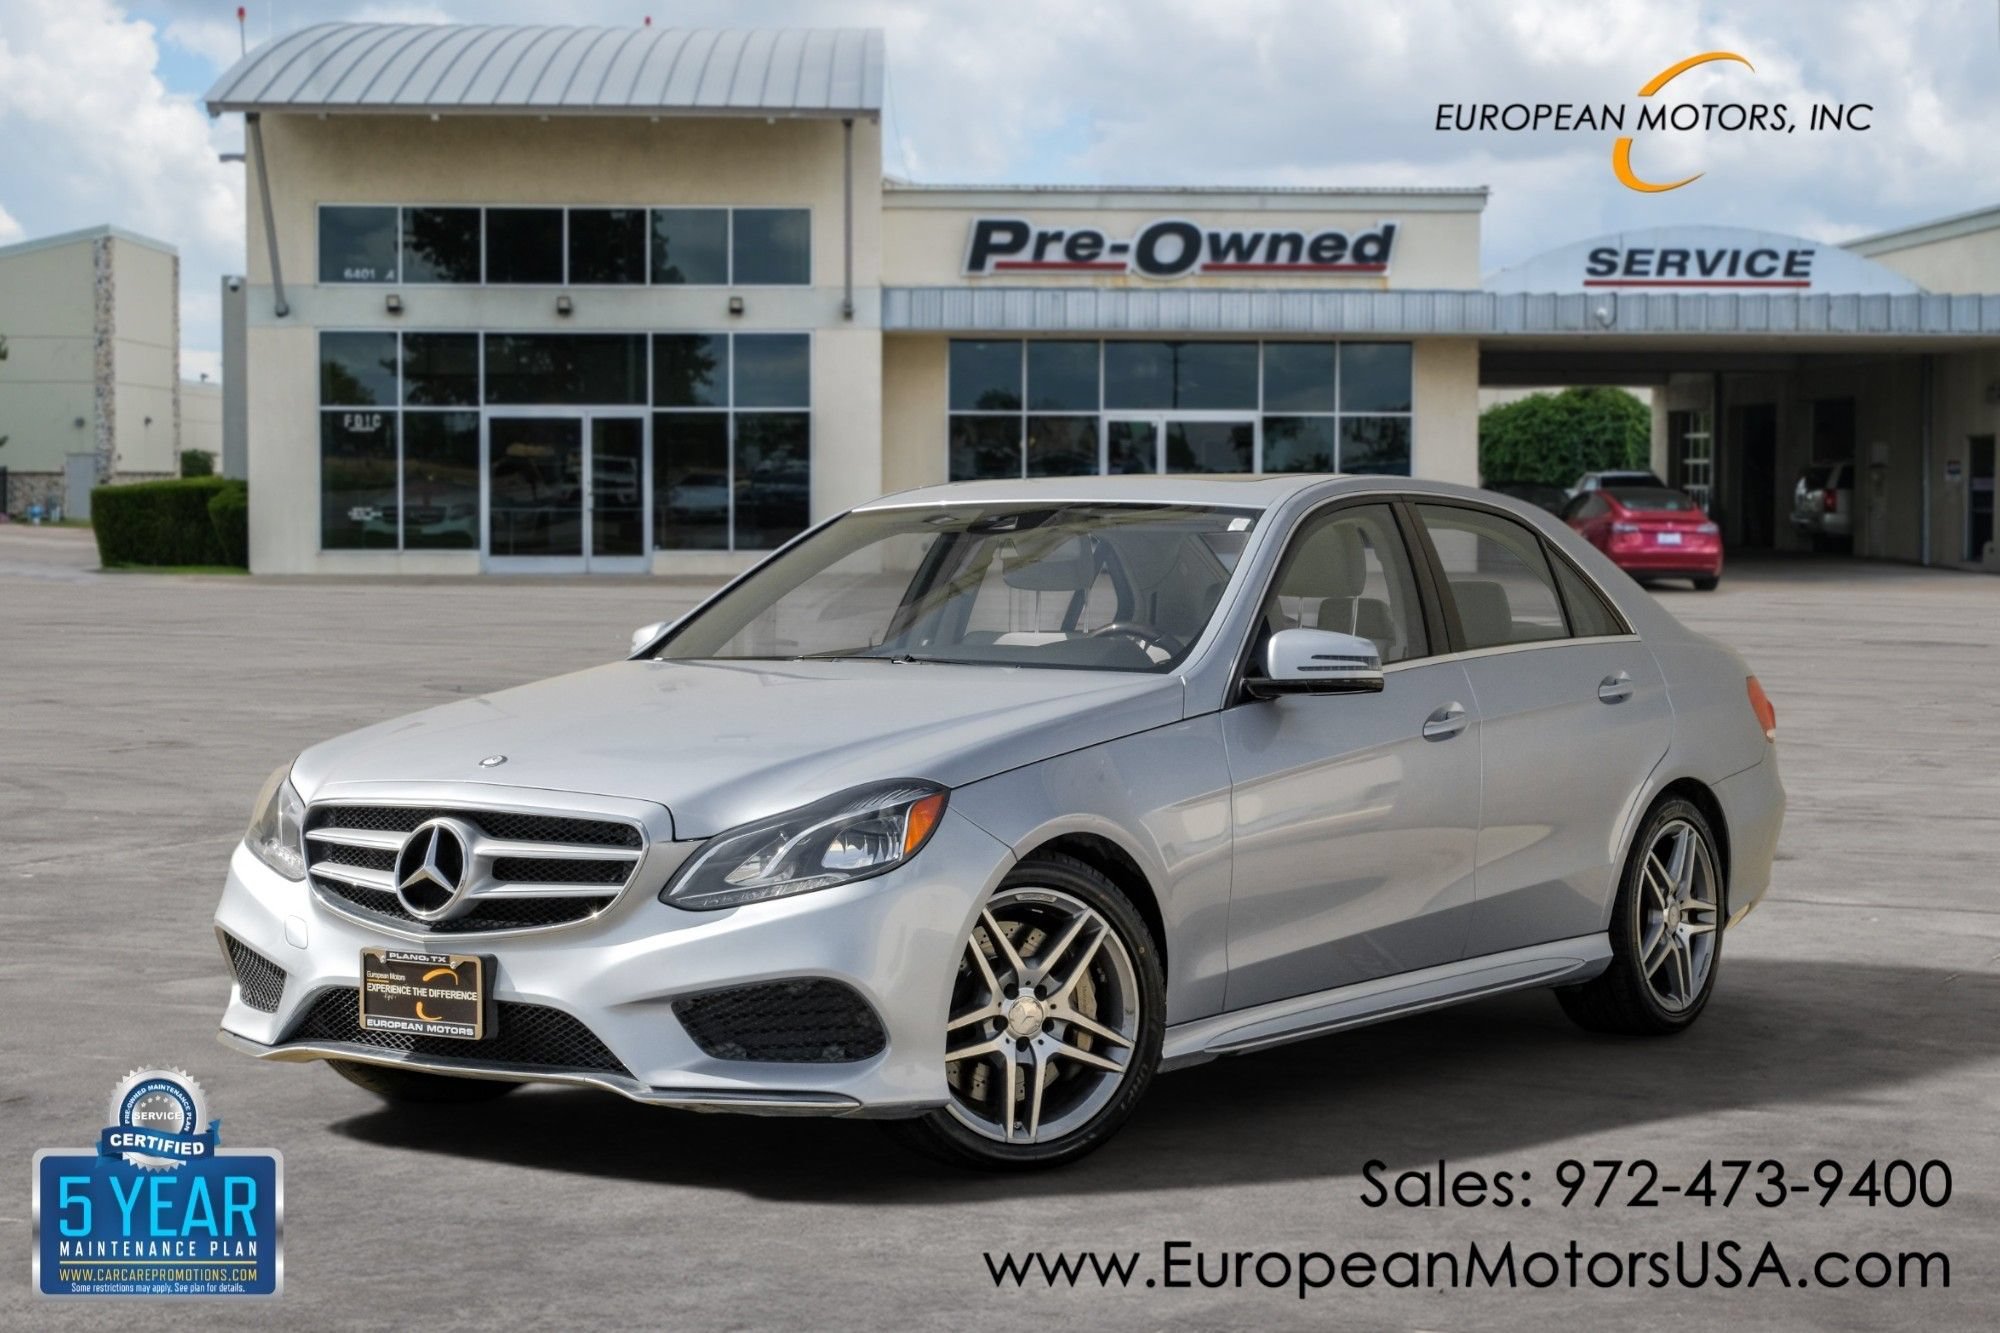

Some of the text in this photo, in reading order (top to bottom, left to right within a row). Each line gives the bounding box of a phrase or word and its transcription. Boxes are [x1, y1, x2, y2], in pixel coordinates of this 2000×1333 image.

[967, 219, 1396, 276] Pre-Owned
[1585, 247, 1815, 278] SERVICE
[431, 955, 447, 963] TX
[366, 970, 406, 981] European Motors
[367, 983, 478, 1001] EXPERIENCE THE DIFFERENCE
[367, 1019, 474, 1036] EUROPEAN MOTORS
